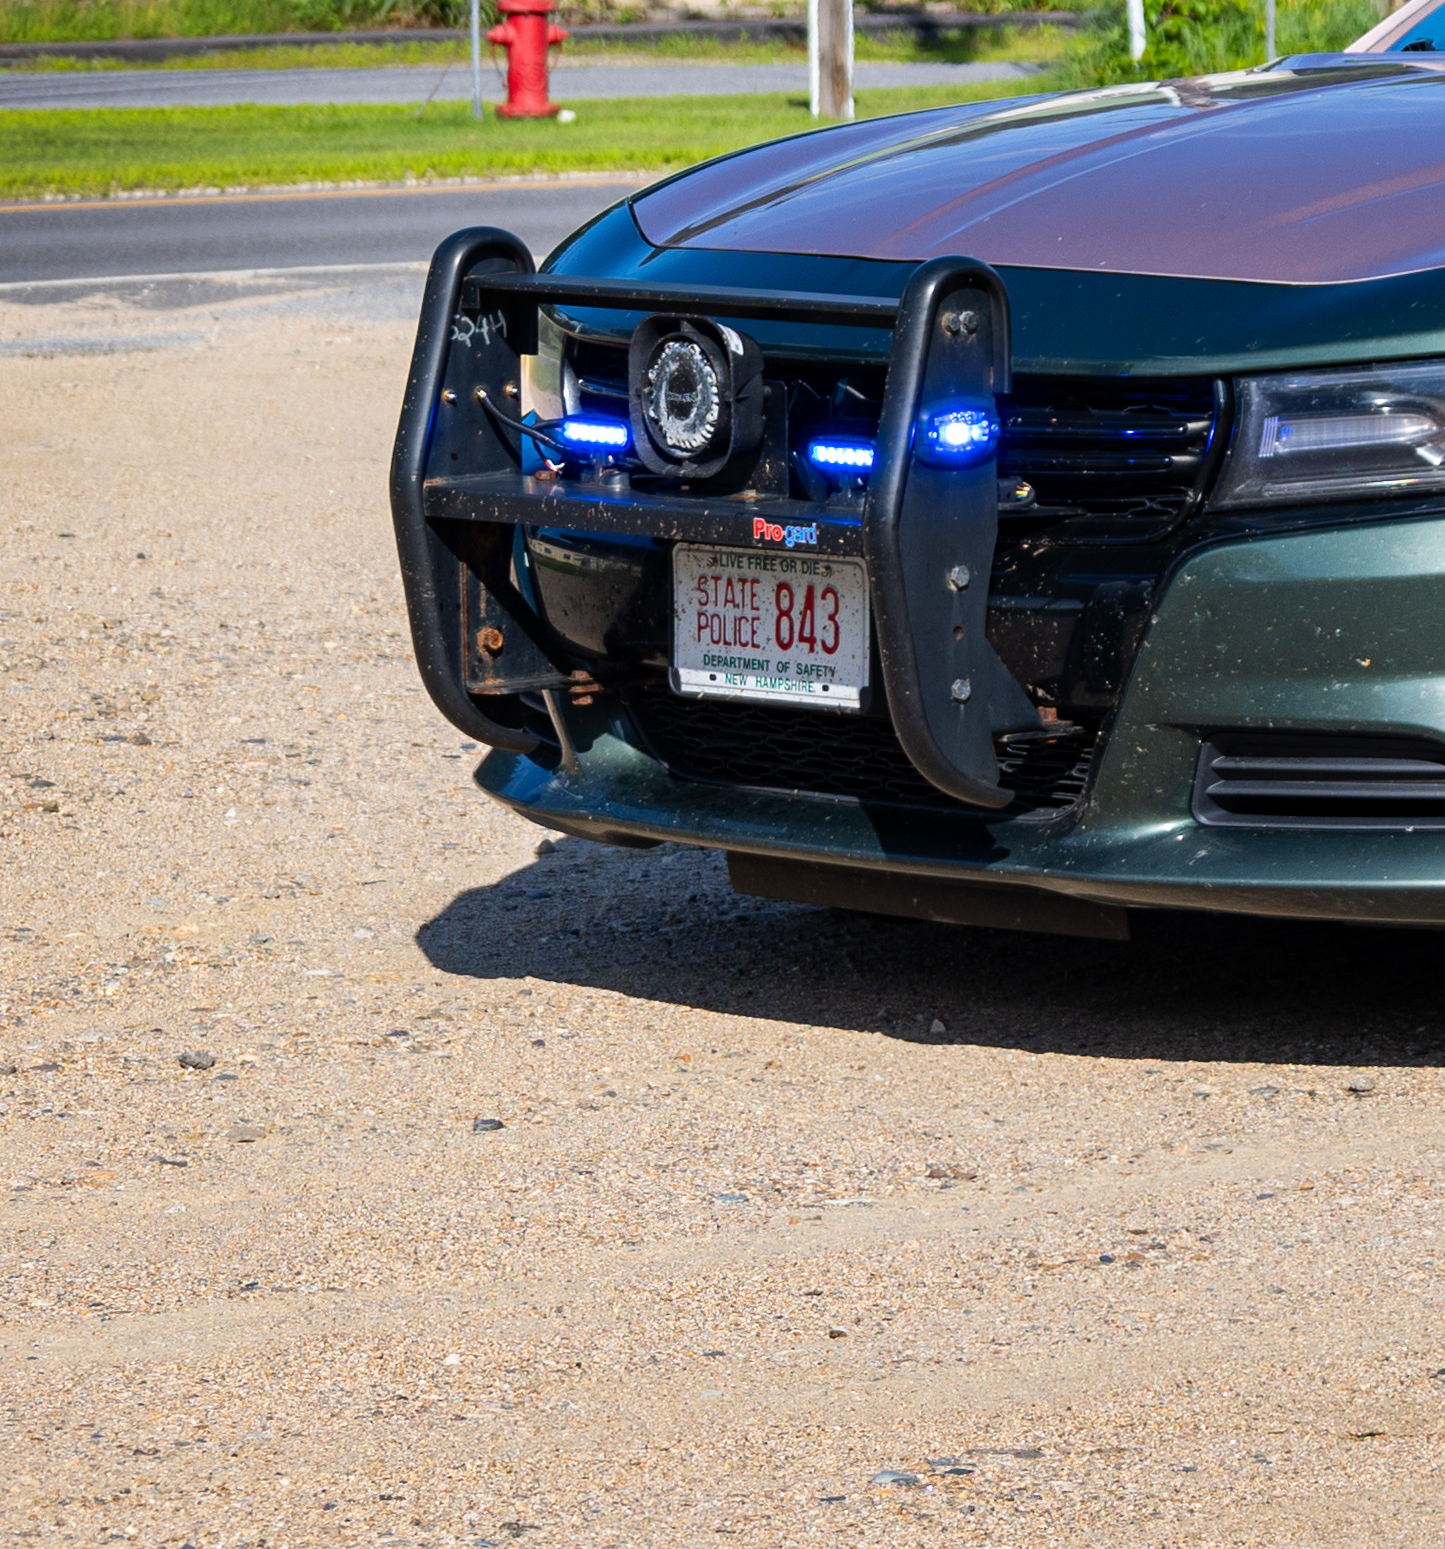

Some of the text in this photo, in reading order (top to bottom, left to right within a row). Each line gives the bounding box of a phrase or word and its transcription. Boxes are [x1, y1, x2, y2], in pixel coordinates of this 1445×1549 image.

[719, 554, 820, 576] LIVE FREE OR DIE
[697, 575, 760, 611] STATE
[697, 612, 761, 649] POLICE
[775, 582, 840, 655] 843
[703, 653, 836, 678] DEPARTMENT OF SAFETY
[724, 673, 815, 692] NEW HAMPSHIRE
